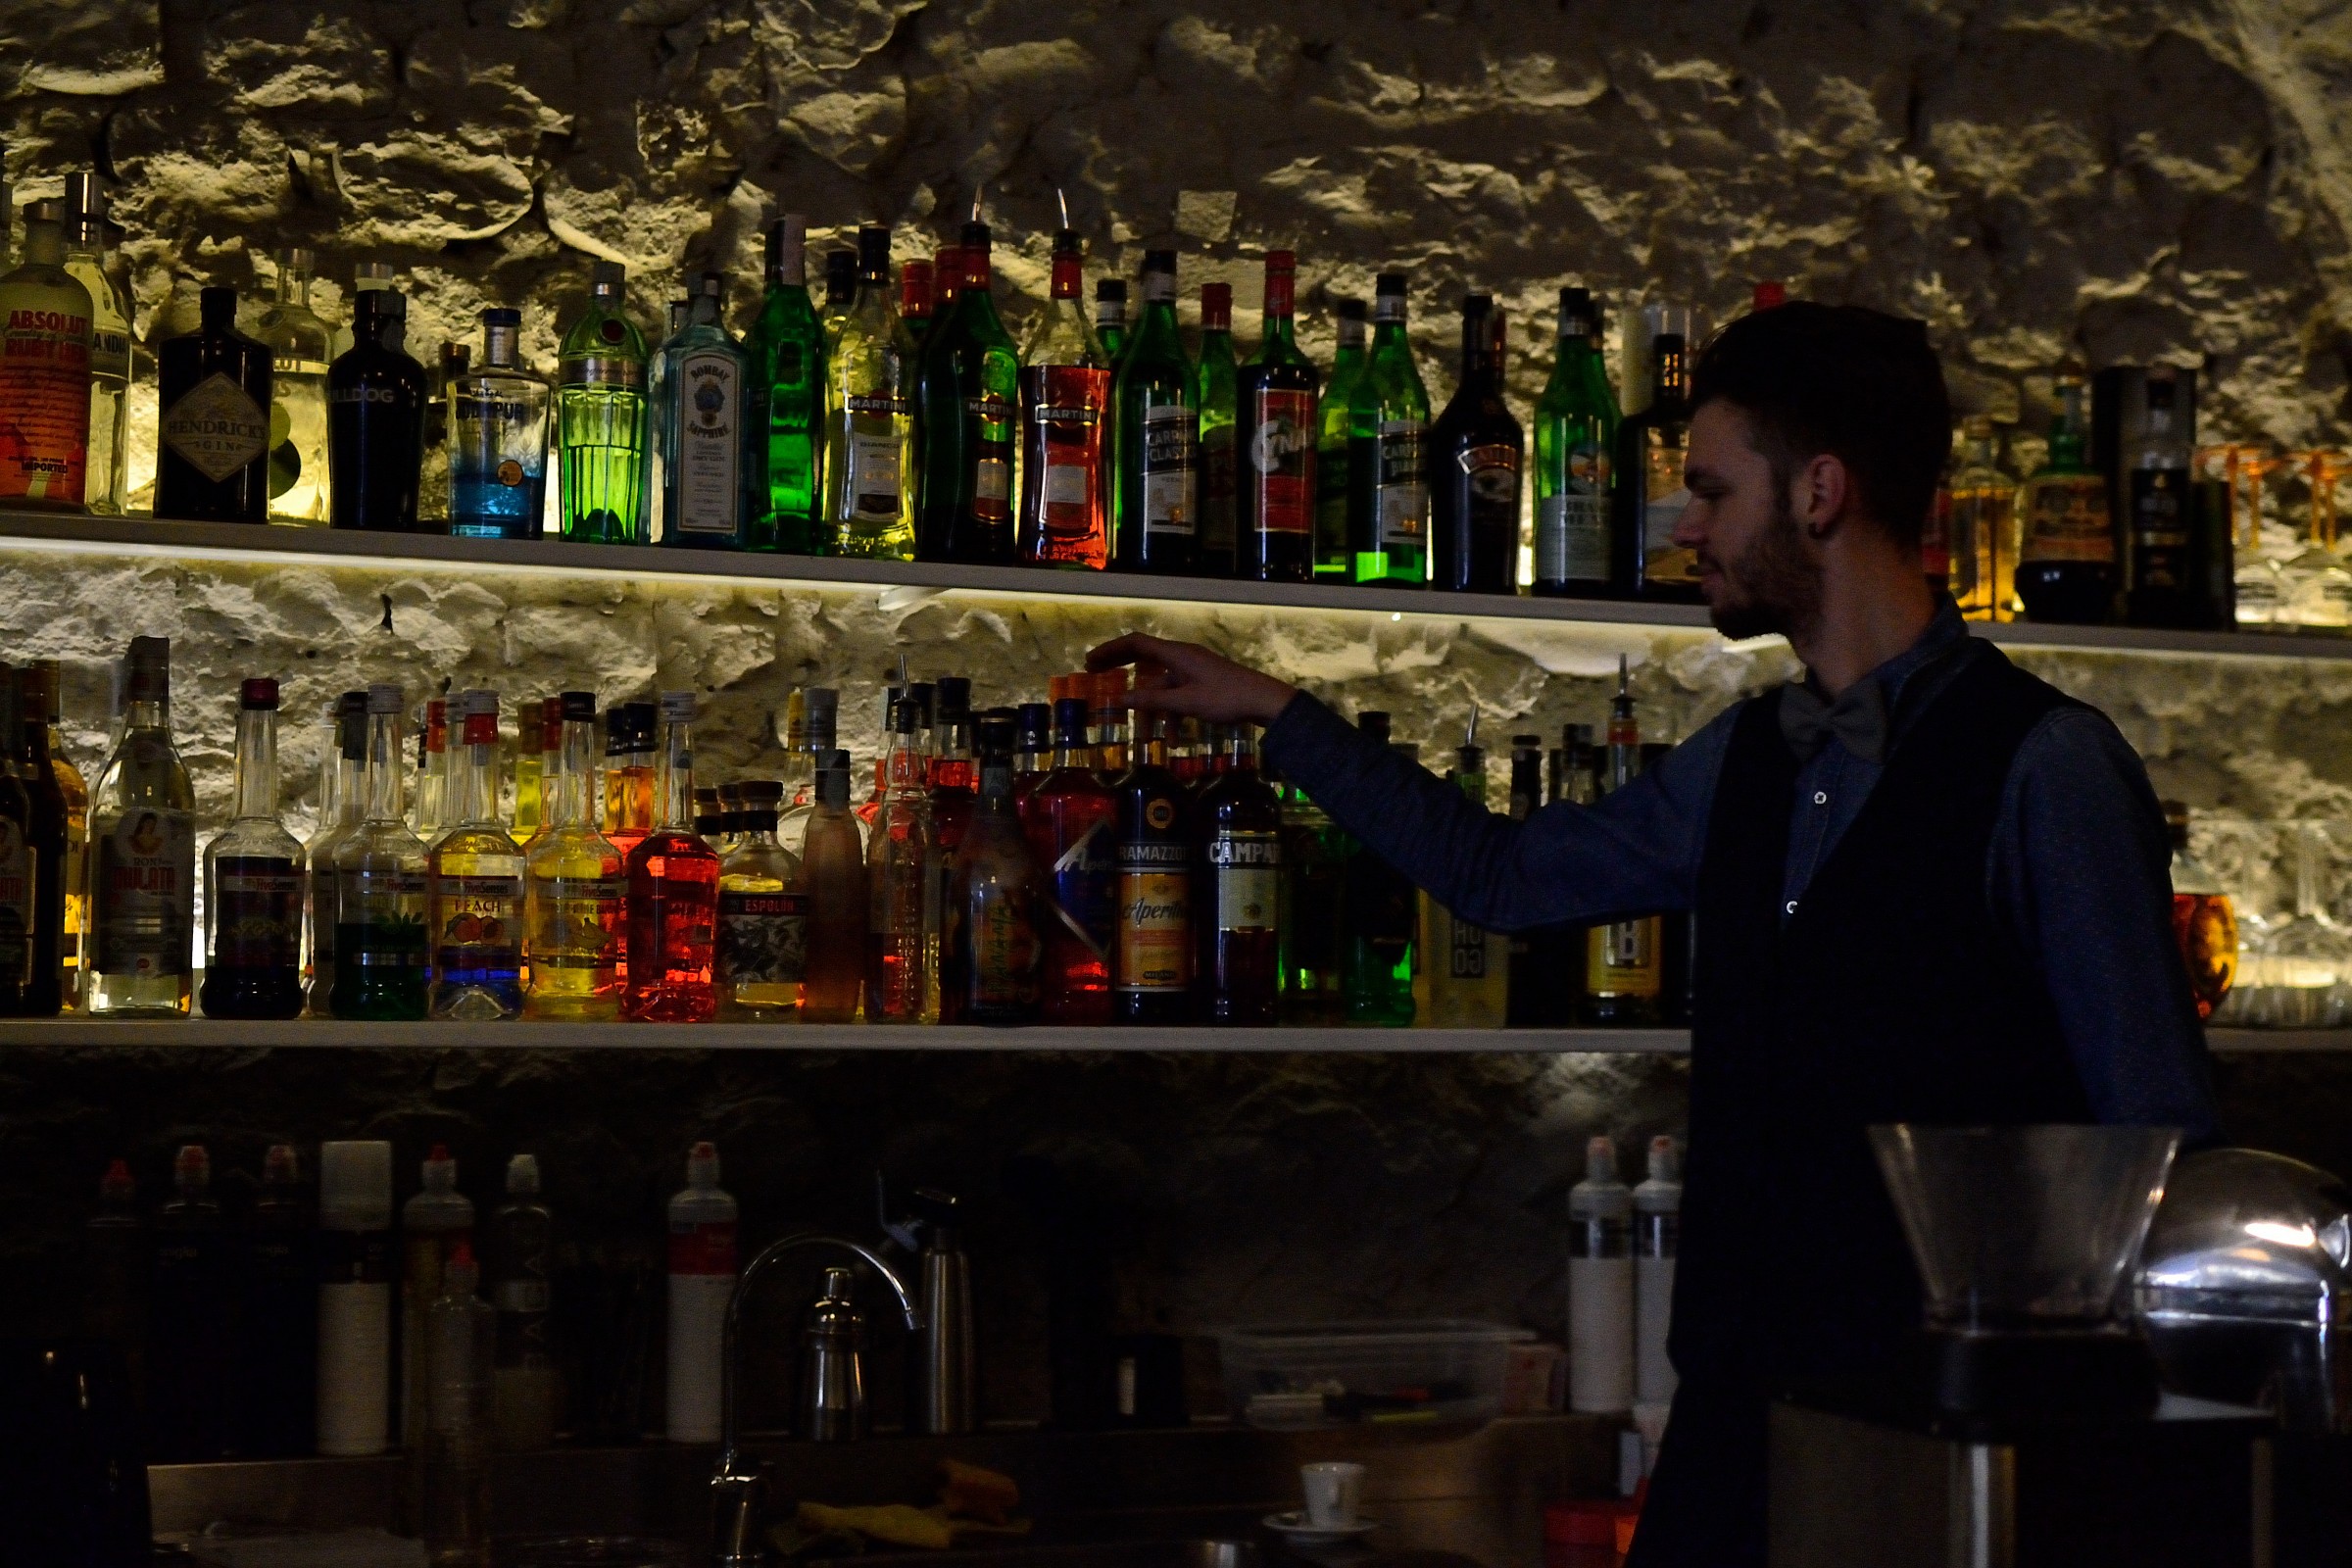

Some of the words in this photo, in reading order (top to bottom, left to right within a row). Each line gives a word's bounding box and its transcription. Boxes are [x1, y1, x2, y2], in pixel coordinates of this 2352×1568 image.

[10, 310, 87, 336] ABSOLUT
[691, 365, 730, 382] BOMBAY
[850, 398, 906, 411] MARTINI
[1039, 408, 1097, 421] MARTINI
[168, 420, 267, 439] HENDRICK'S
[686, 420, 731, 439] SAPPHIRE
[202, 440, 238, 451] GIN
[21, 462, 69, 474] IMPORTED
[133, 858, 157, 866] RON
[454, 900, 502, 912] PEACH
